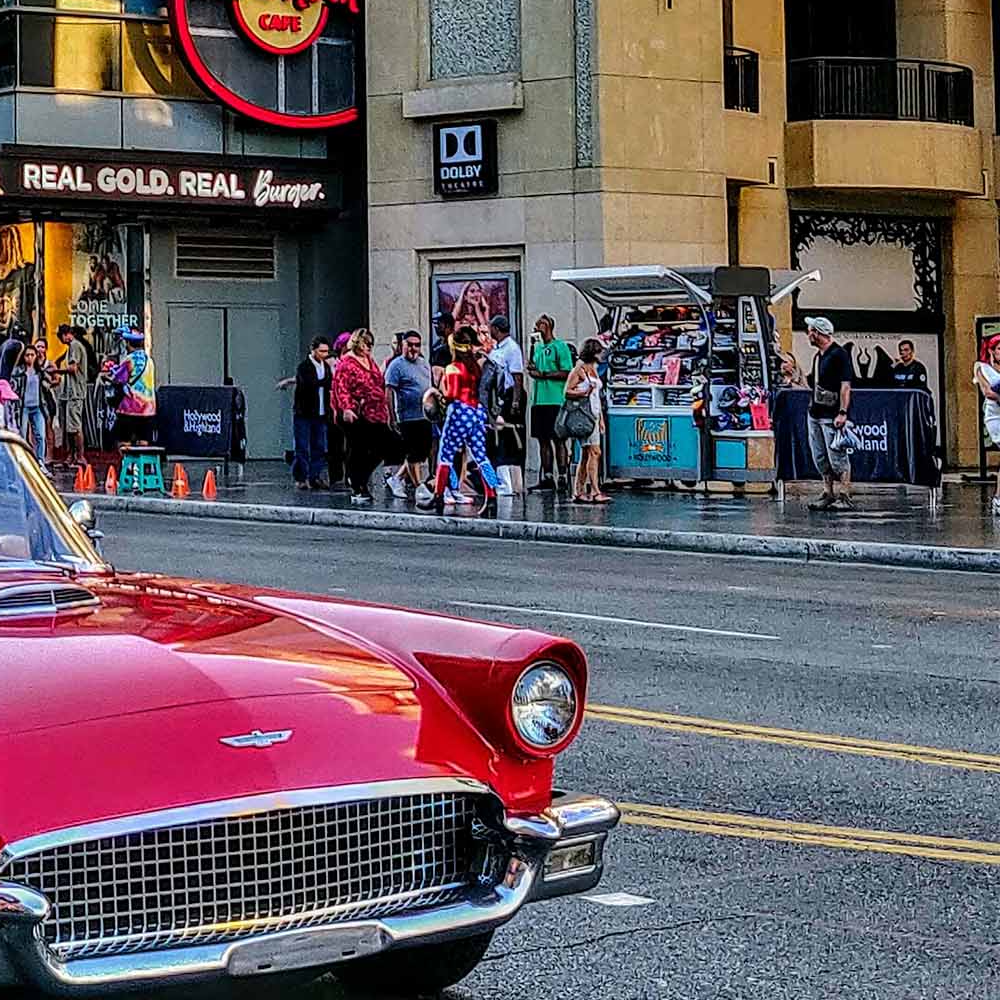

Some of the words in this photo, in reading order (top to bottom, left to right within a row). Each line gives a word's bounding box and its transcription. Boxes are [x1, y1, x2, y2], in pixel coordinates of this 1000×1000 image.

[258, 13, 303, 33] CAFE
[22, 163, 93, 192] REAL
[96, 166, 175, 196] GOLD.
[179, 171, 246, 199] REAL
[440, 164, 482, 180] DOLBY
[68, 313, 139, 328] TOGETHER
